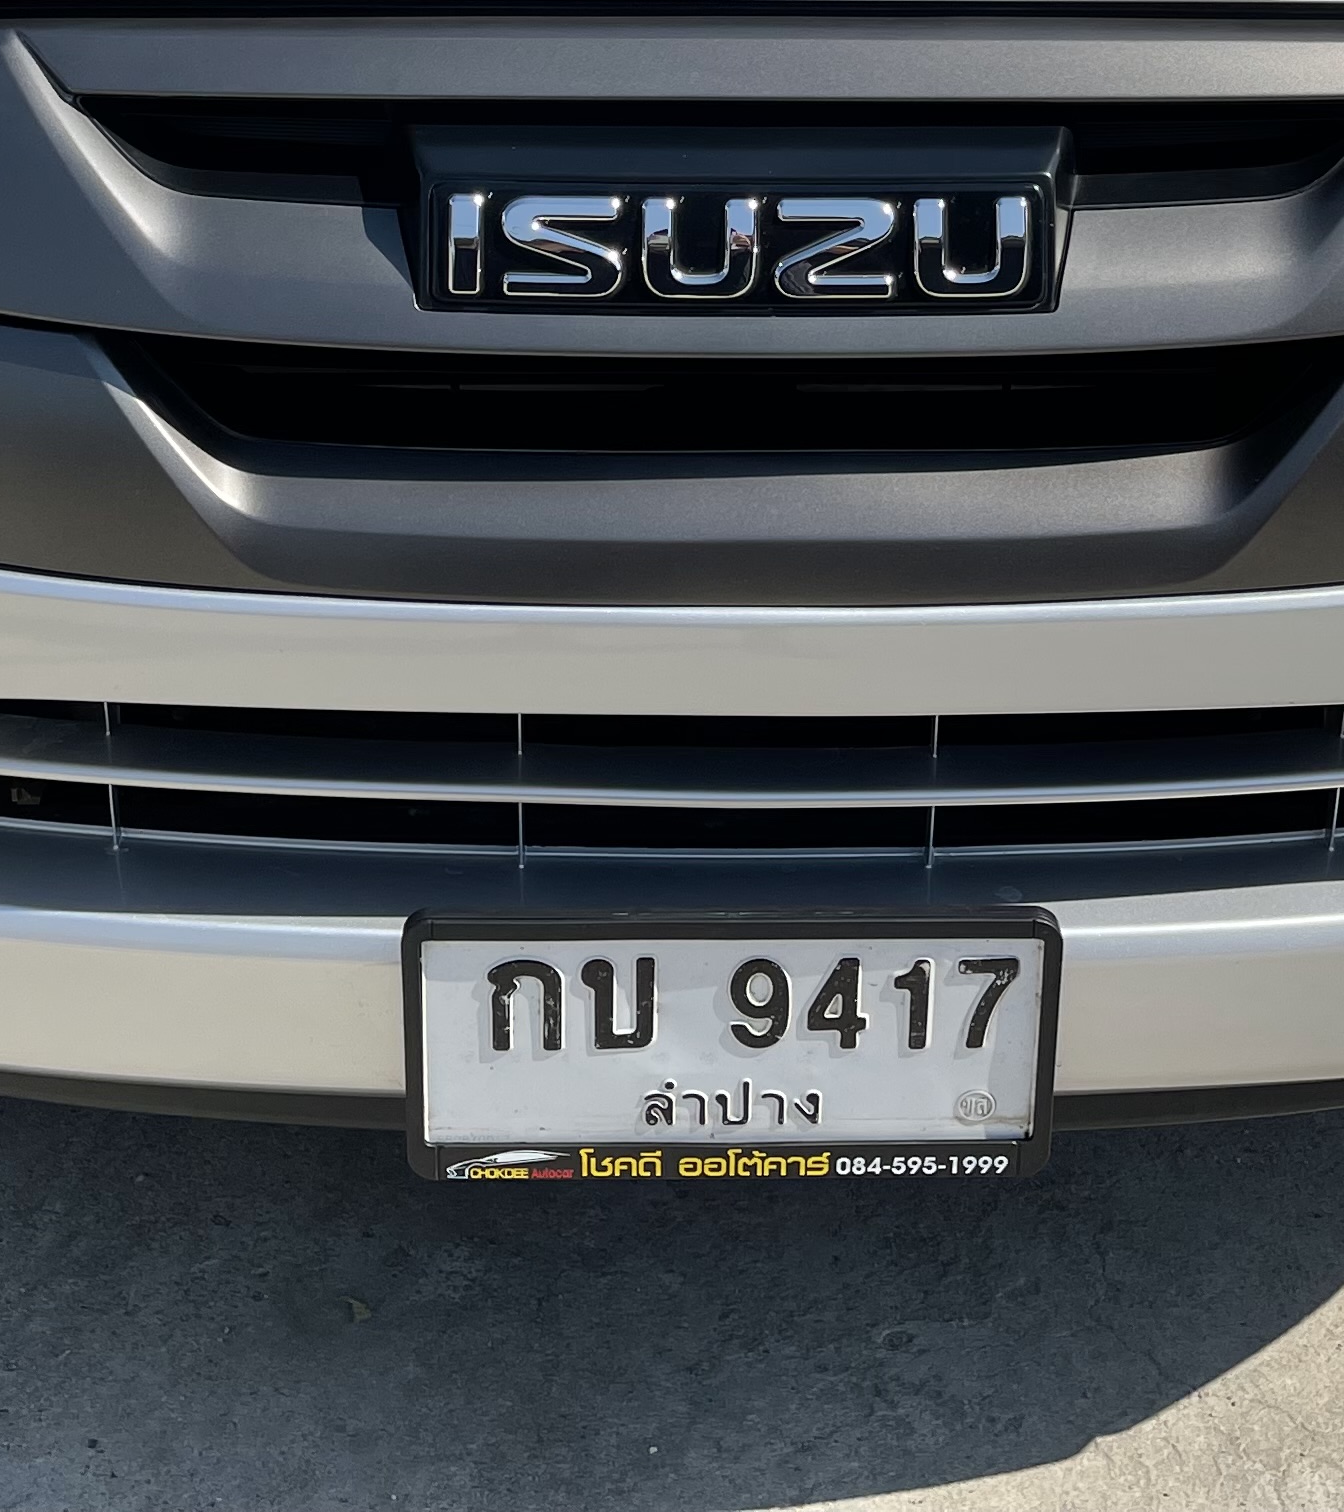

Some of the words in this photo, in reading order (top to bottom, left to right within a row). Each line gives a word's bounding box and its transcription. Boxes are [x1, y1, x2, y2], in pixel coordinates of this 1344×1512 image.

[448, 192, 1029, 299] ISUZU
[487, 957, 655, 1051] กบ
[729, 957, 1020, 1050] 9417
[643, 1079, 821, 1126] ลำปาง
[469, 1167, 529, 1179] CHOKDEE
[531, 1167, 574, 1179] Autocar
[579, 1148, 662, 1177] โชคดี
[678, 1148, 831, 1177] ออโต้คาร์
[835, 1155, 1009, 1176] 084-595-1999
